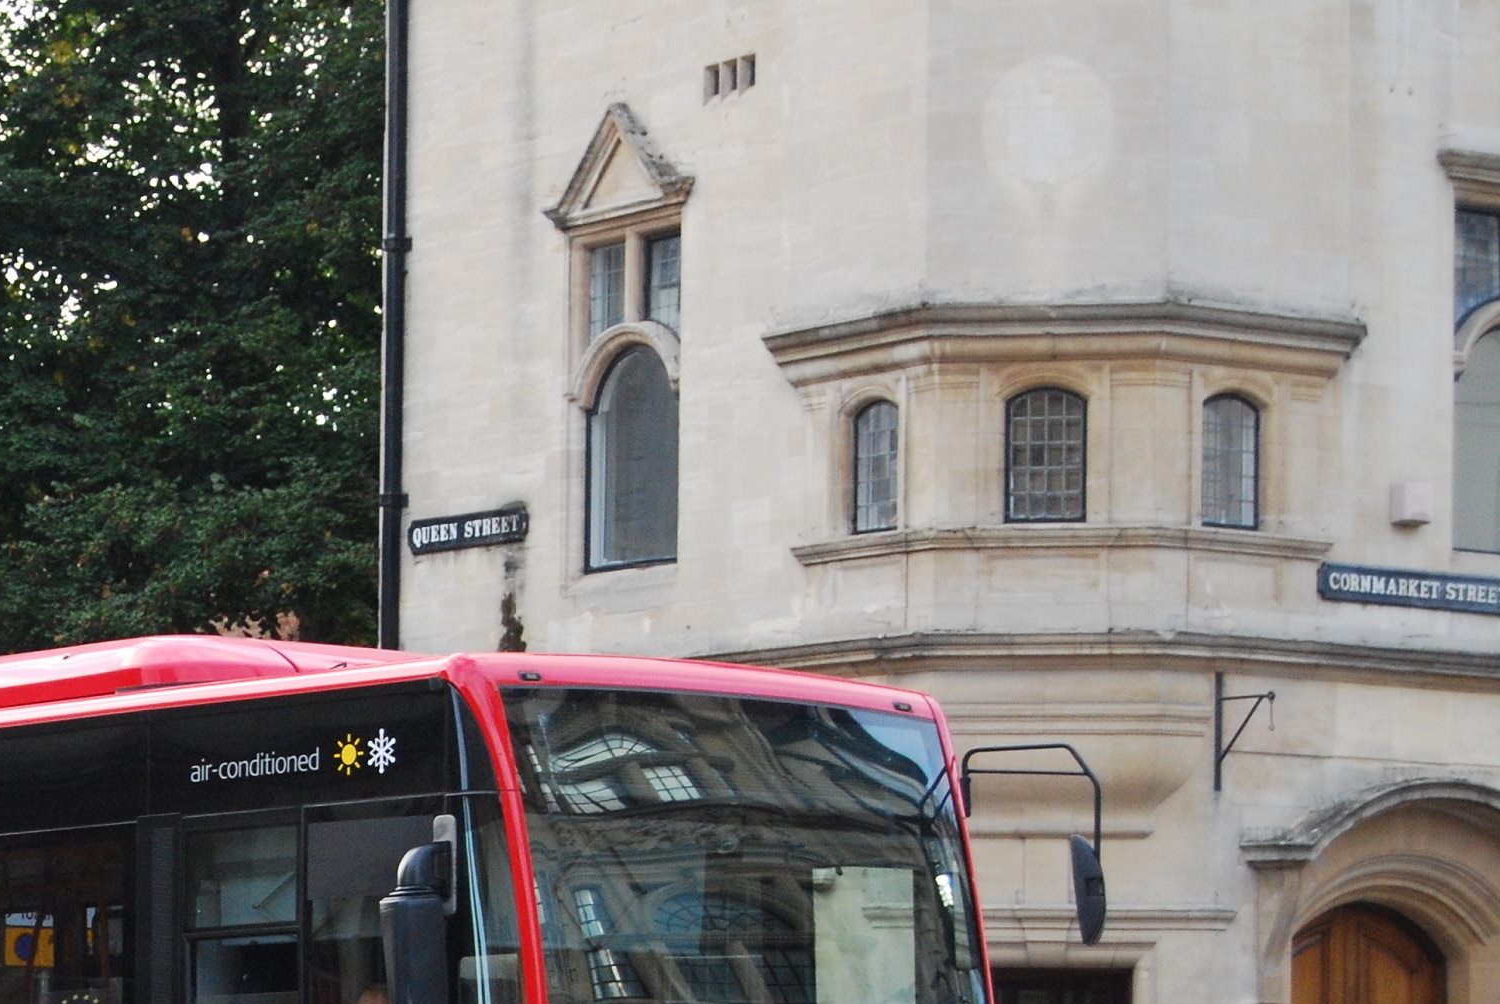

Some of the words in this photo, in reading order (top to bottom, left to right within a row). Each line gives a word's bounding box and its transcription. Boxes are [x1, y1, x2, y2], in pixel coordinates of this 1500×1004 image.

[412, 522, 458, 548] QUEEN
[464, 514, 520, 538] STREET
[1328, 572, 1440, 599] CORNMARKET
[1445, 582, 1500, 604] STREE
[190, 746, 320, 783] air-conditioned
